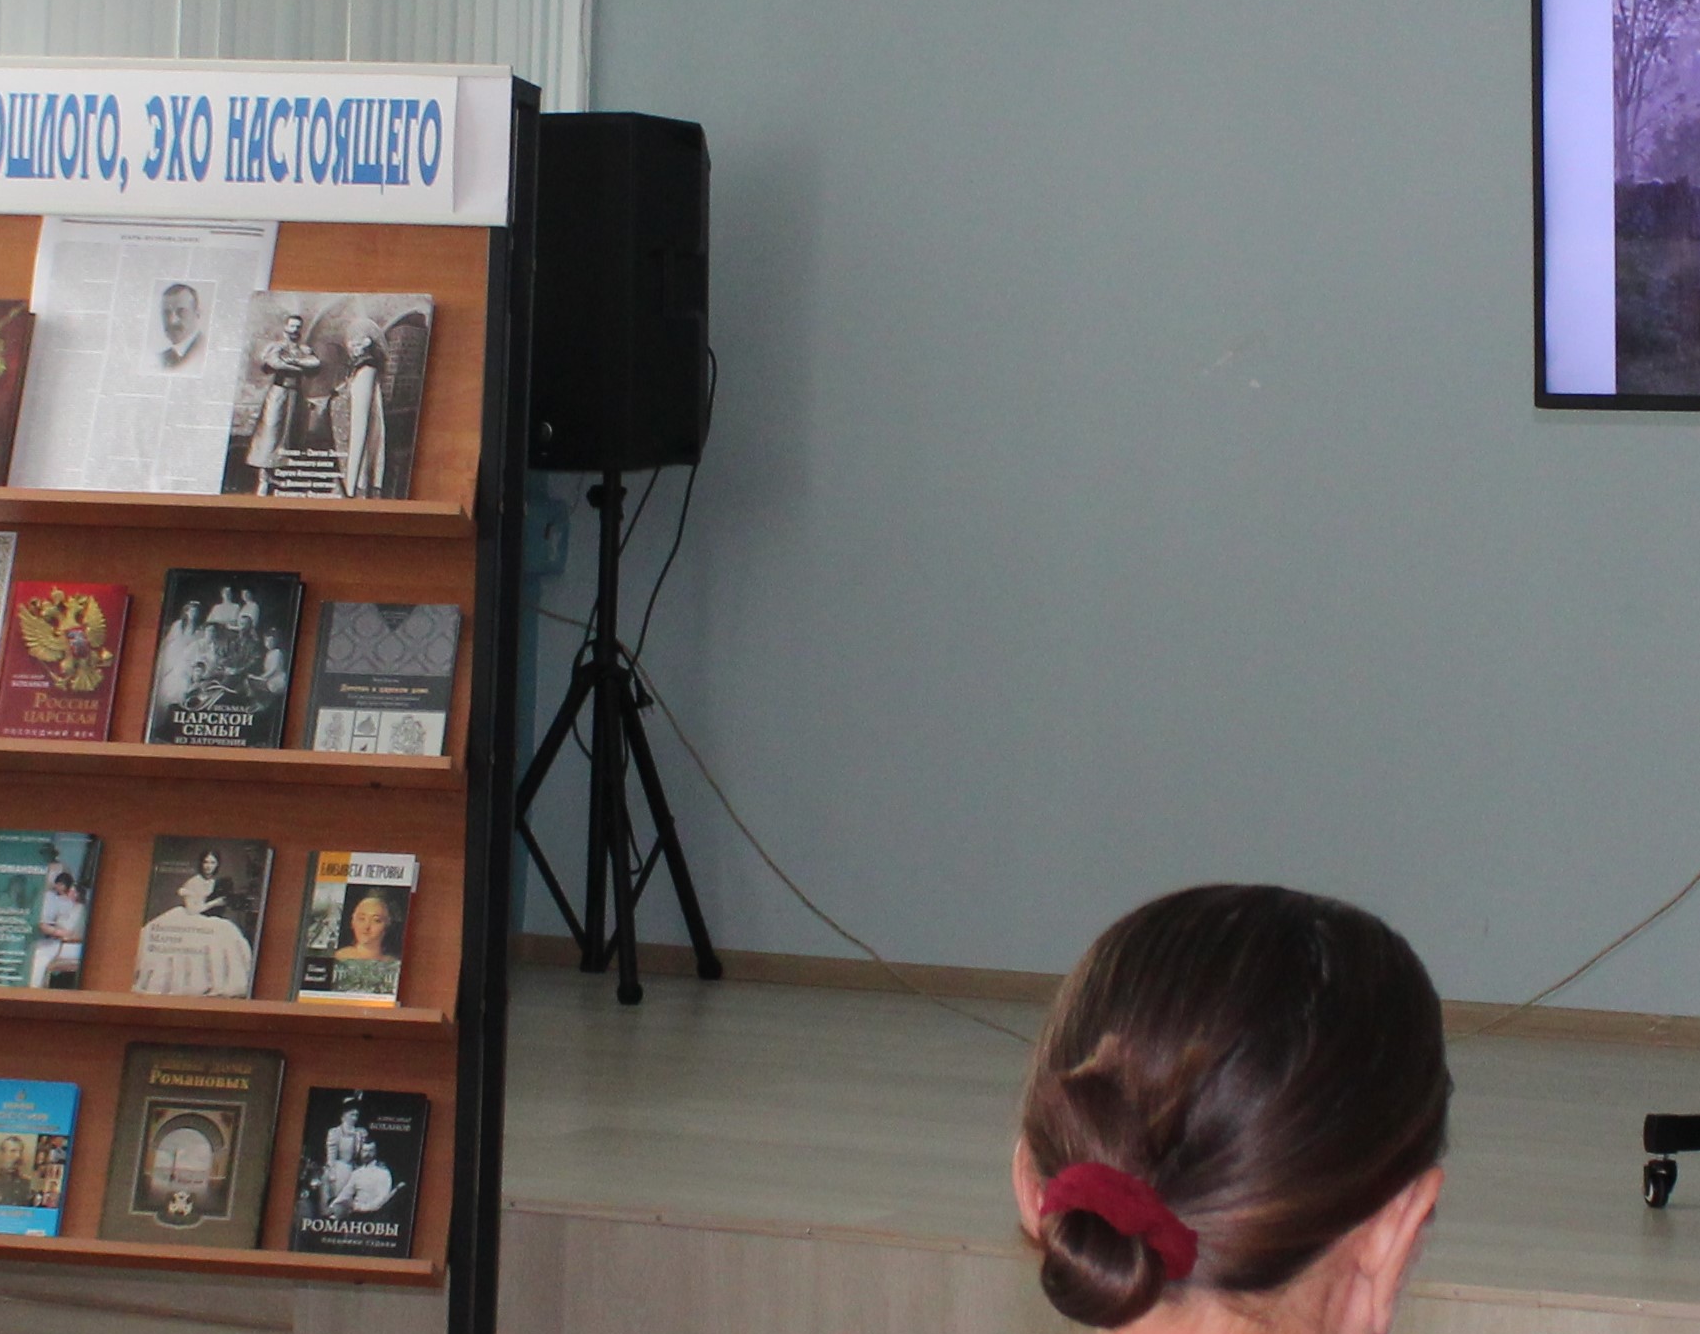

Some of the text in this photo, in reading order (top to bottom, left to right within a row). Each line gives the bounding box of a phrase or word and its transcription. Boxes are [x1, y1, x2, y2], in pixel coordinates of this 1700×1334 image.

[142, 94, 214, 183] ЭХО
[223, 96, 443, 196] НАСТОЯЩЕГО
[173, 711, 254, 727] ЦАРСКОЙ
[182, 724, 241, 738] СЕМЬИ
[364, 863, 406, 880] ПЕТРОВНА
[301, 1218, 400, 1237] РОМАНОВЫ
